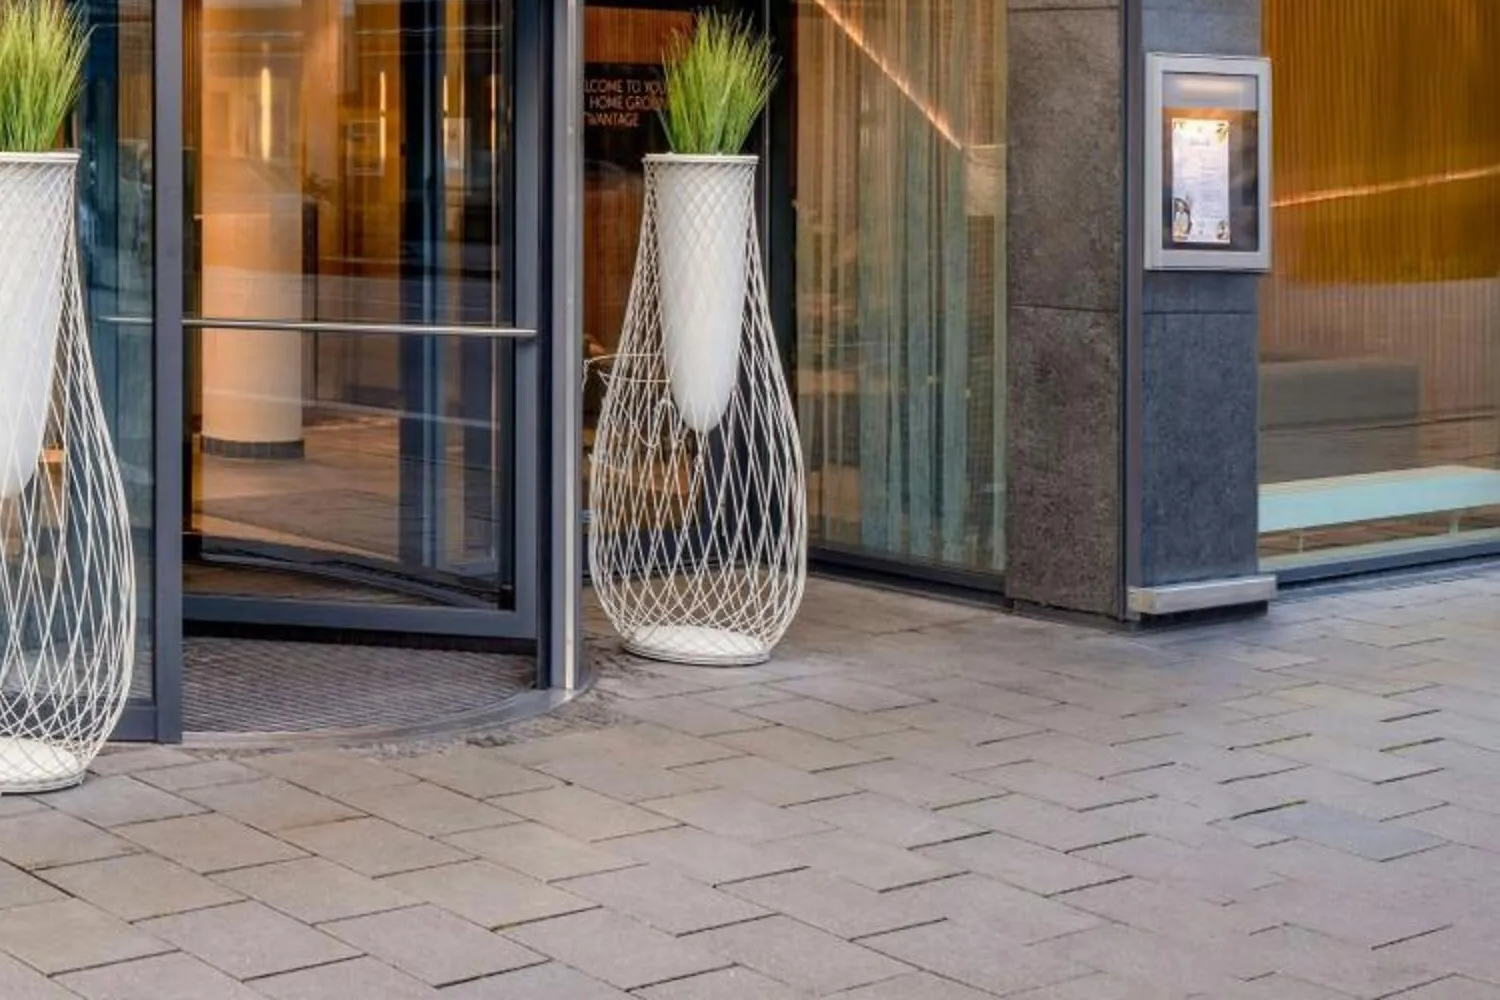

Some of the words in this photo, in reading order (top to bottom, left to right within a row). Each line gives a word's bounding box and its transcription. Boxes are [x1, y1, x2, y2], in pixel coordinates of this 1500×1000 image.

[585, 78, 625, 94] LCOME
[626, 78, 642, 94] TO
[589, 95, 625, 110] HOME
